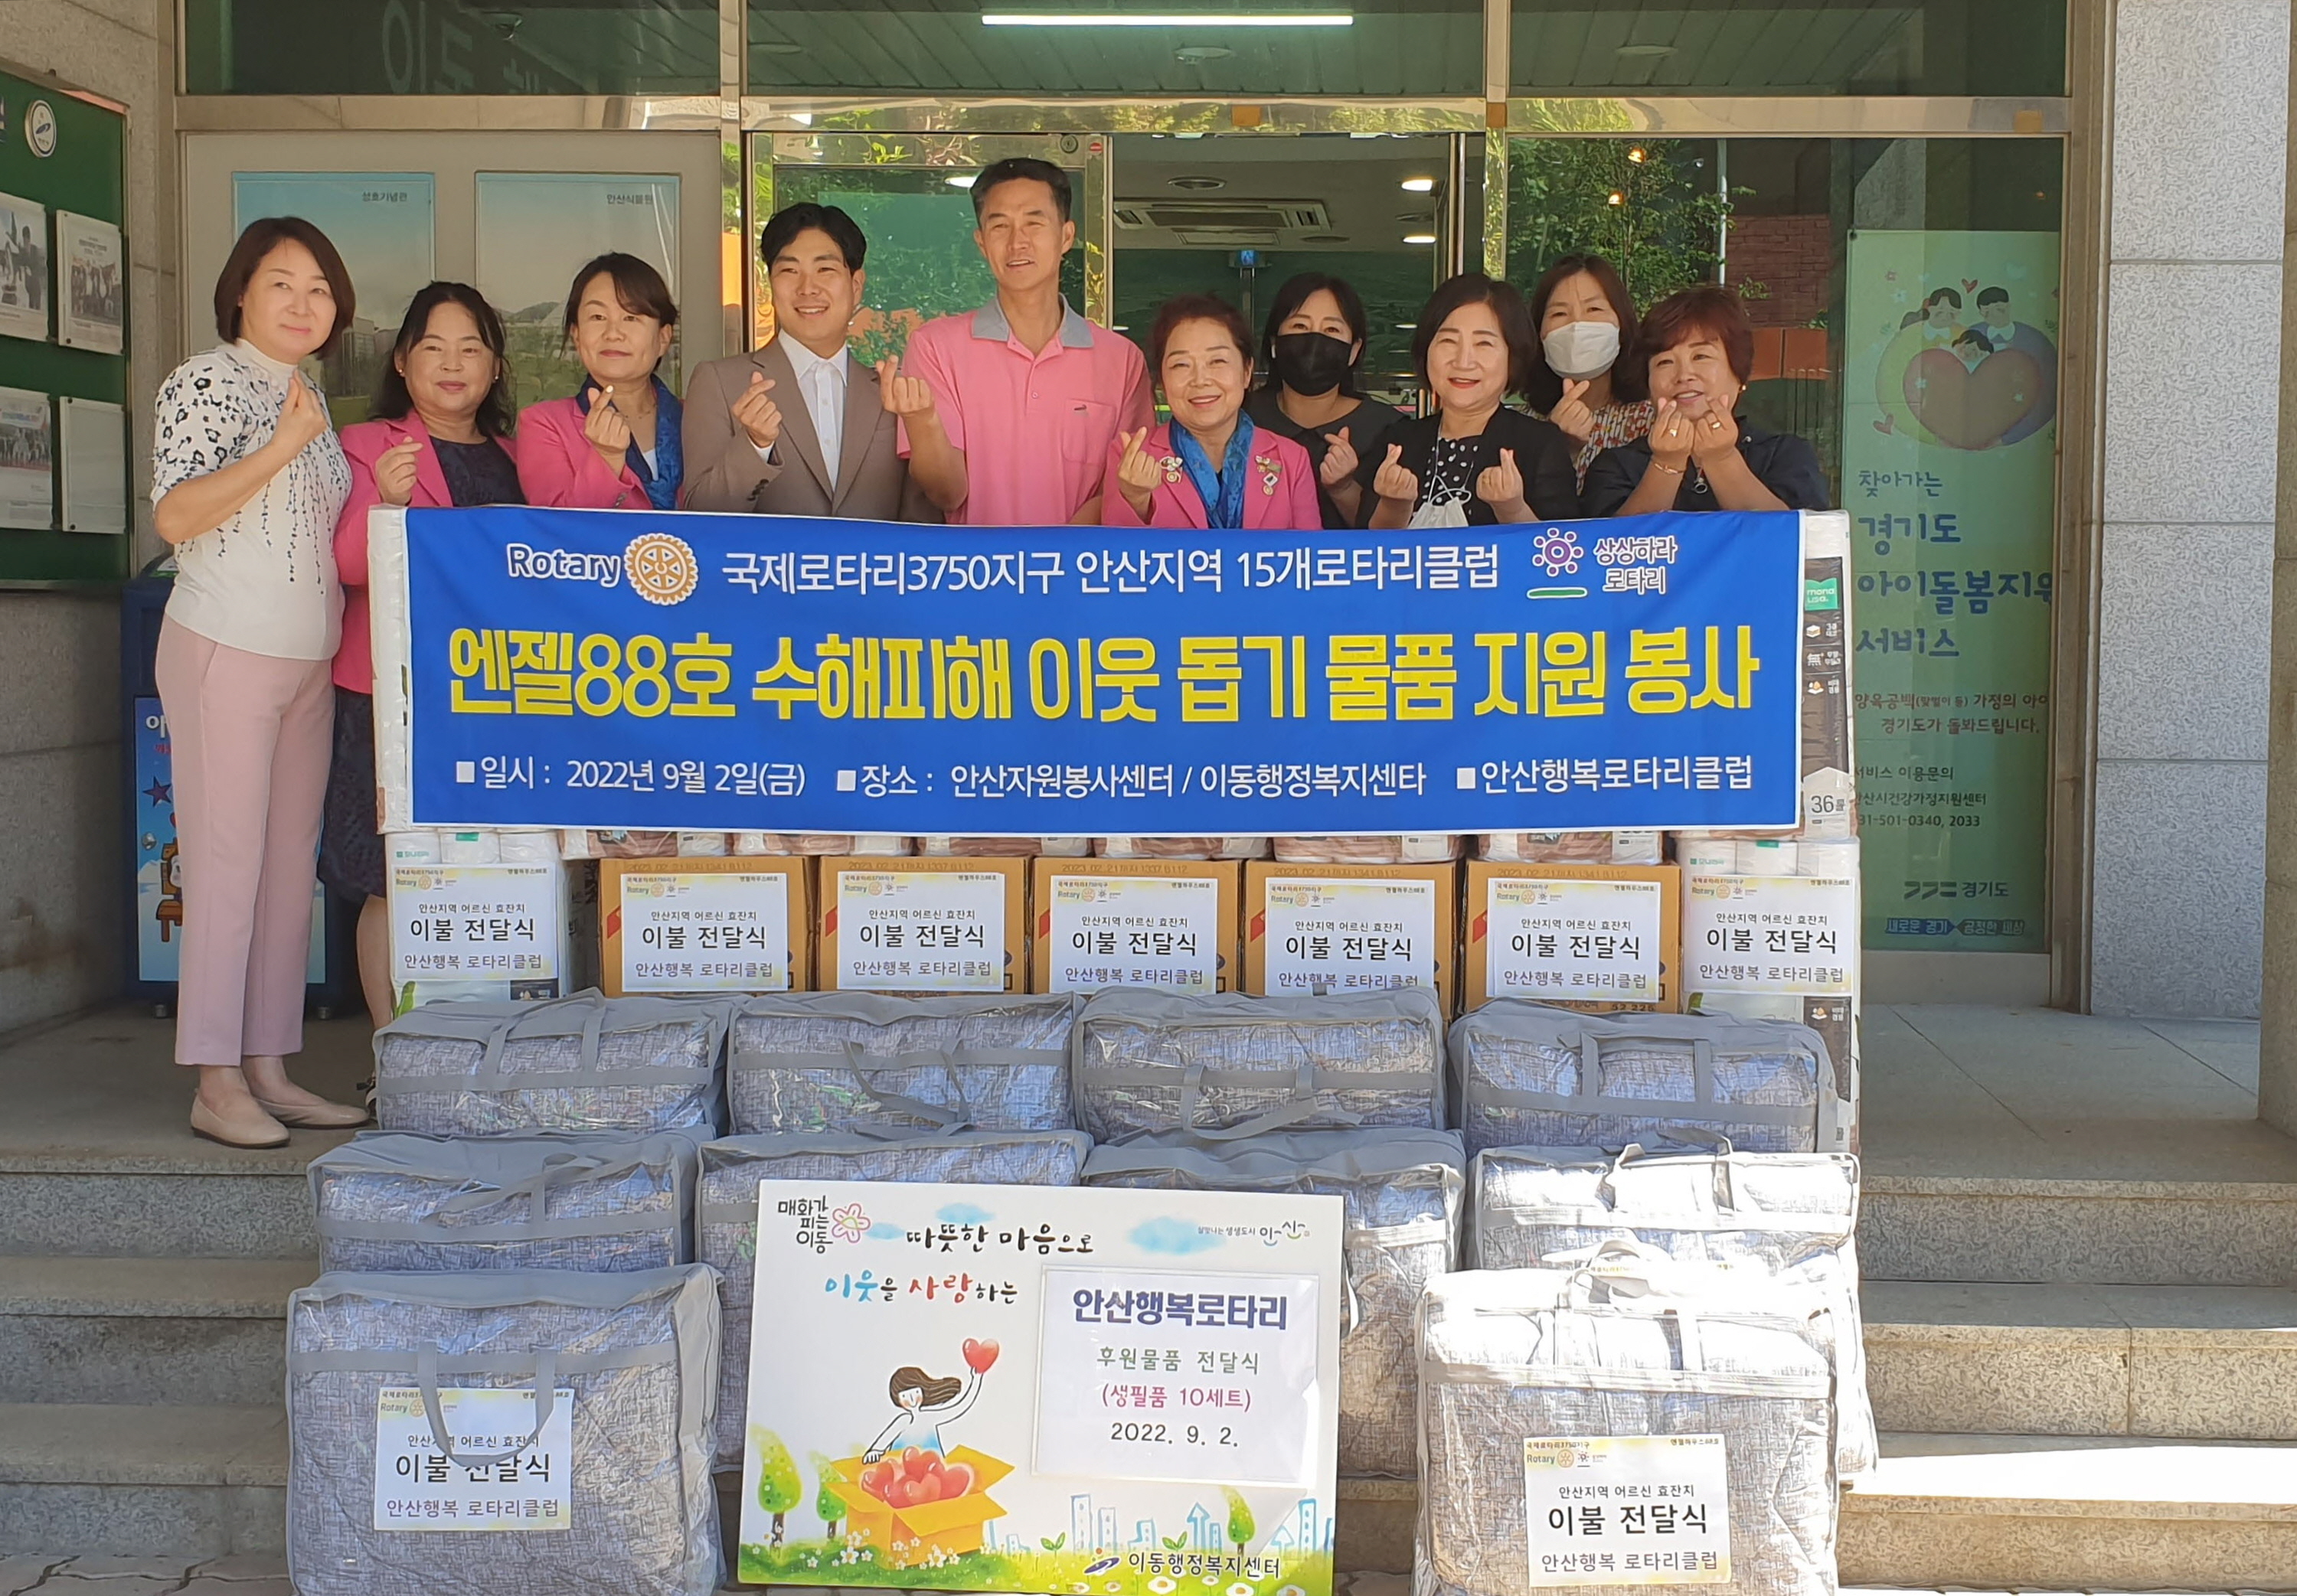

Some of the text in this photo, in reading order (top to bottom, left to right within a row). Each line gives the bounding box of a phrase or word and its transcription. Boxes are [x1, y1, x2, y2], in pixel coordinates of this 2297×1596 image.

[1858, 470, 1943, 498] 찾아가는
[1858, 513, 1962, 555] 경기도
[1593, 535, 1678, 564] 상상하라
[505, 543, 622, 587] Rotary
[722, 543, 1498, 595] 국제로타리3750지구 안산지역 15개로타리클럽
[1602, 566, 1666, 595] 로타리
[1855, 628, 1959, 657] 서비스
[449, 625, 1760, 722] 엔젤88호 수해피해 이웃 돕기 물품 지원 봉사
[1973, 694, 2017, 710] 가정의
[1880, 718, 1942, 733] 경기도가
[482, 756, 534, 789] 일시
[567, 761, 655, 792] 2022년
[664, 762, 706, 794] 9월
[716, 762, 805, 797] 2일(금)
[861, 765, 917, 798] 장소
[951, 763, 1173, 798] 안산자원봉사센터
[1201, 764, 1426, 796] 이동행정복지센타
[1481, 755, 1752, 794] 안산행복로타리클럽
[1858, 814, 1981, 828] 31-501-0340, 2033
[1962, 882, 2008, 898] 경기도
[419, 904, 524, 913] 안산지역 어르신 효잔치
[652, 912, 756, 921] 안산지역 어르신 효잔치
[869, 910, 975, 919] 안산지역 어르신 효잔치
[1717, 913, 1827, 925] 안산지역 어르신 효잔치
[411, 919, 533, 941] 이불 전달식
[1082, 917, 1187, 928] 안산지역 어르신 효잔치
[1296, 922, 1402, 932] 안산지역 어르신 효잔치
[1521, 919, 1630, 931] 안산지역 어르신 효잔치
[1926, 920, 1948, 934] 경기
[643, 927, 764, 949] 이불 전달식
[861, 925, 982, 948] 이불 전달식
[1073, 932, 1195, 956] 이불 전달식
[1512, 934, 1639, 960] 이불 전달식
[1707, 929, 1835, 954] 이불 전달식
[1286, 936, 1410, 961] 이불 전달식
[405, 955, 541, 969] 안산행복 로타리클럽
[636, 961, 772, 977] 안산행복 로타리클럽
[854, 961, 990, 976] 안산행복 로타리클럽
[1066, 968, 1203, 986] 안산행복 로타리클럽
[1505, 971, 1645, 989] 안산행복 로타리클럽
[1700, 965, 1844, 982] 안산행복 로타리클럽
[778, 1195, 828, 1216] 매화가
[800, 1214, 829, 1229] 피는
[796, 1230, 833, 1254] 이동
[907, 1223, 1093, 1255] 따뜻한 마음으로
[825, 1270, 1018, 1304] 이웃을 사랑하는
[1073, 1289, 1287, 1330] 안산행복로타리
[1096, 1346, 1260, 1375] 후원물품 전달식
[381, 1402, 408, 1414] Rotary
[1101, 1384, 1252, 1412] (생필품 10세트)
[461, 1435, 497, 1447] 어르신
[1111, 1423, 1239, 1448] 2022. 9. 2.
[396, 1454, 450, 1483] 이불
[1528, 1454, 1555, 1464] Rotary
[1560, 1485, 1694, 1499] 안산지역 어르신 효잔치
[387, 1500, 558, 1518] 안산행복 로타리클럽
[1549, 1504, 1706, 1536] 이불 전달식
[1127, 1552, 1280, 1580] 이동행정복지센터
[1542, 1552, 1717, 1572] 안산행복 로타리클럽
